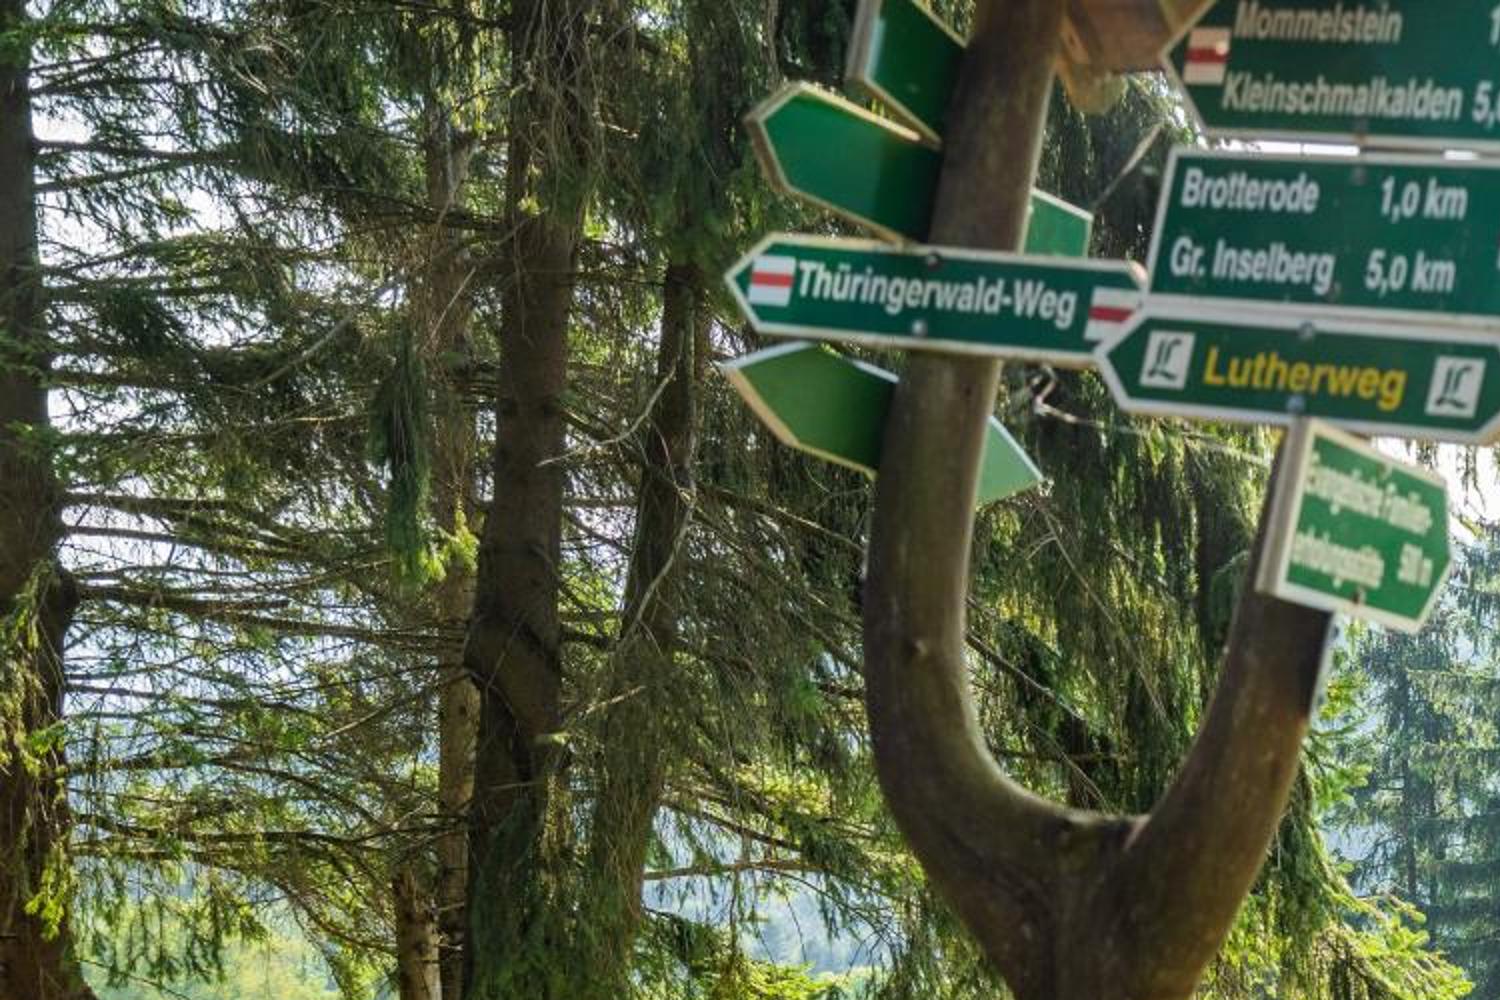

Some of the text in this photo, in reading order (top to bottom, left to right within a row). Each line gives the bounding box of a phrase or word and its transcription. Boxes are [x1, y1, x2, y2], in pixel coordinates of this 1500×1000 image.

[1222, 73, 1463, 121] Kleinschmalkalden
[1181, 167, 1468, 223] Brotterode 1,0 km
[798, 261, 1077, 330] Thüringerwald-Weg
[1170, 236, 1456, 298] Gr. Inselberg 5,0 km
[1203, 345, 1407, 412] Lutherweg
